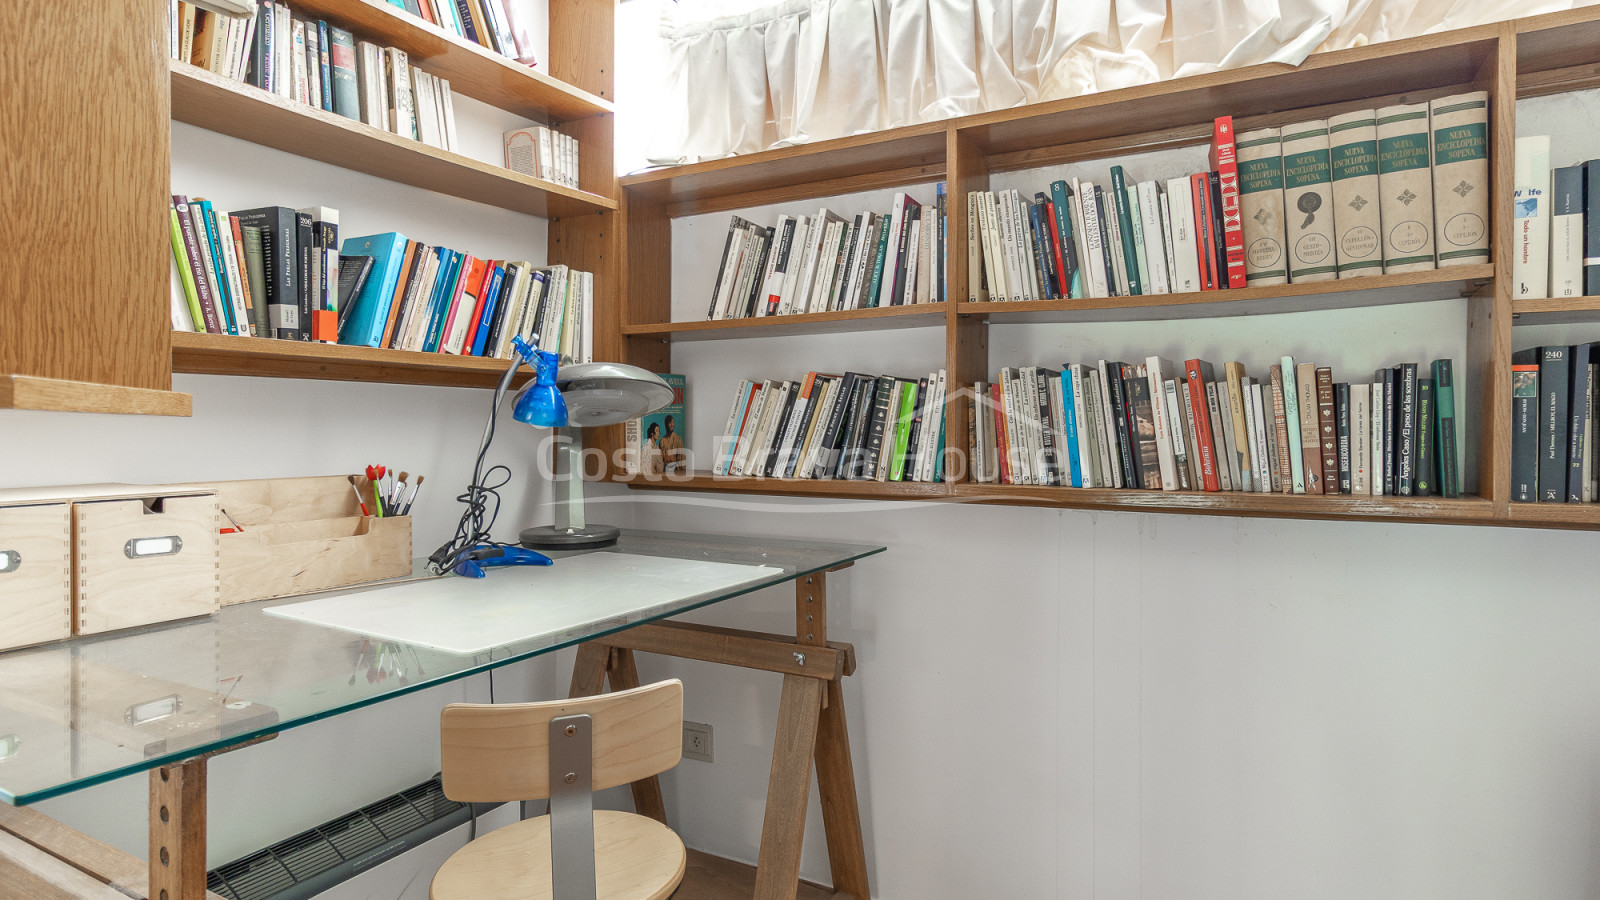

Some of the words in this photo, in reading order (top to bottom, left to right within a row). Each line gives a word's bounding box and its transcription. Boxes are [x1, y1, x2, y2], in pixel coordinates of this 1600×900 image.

[1449, 129, 1472, 140] NUEVA
[1392, 139, 1413, 150] NUEVA
[1344, 147, 1365, 157] NUEVA
[1296, 155, 1316, 165] NUEVA
[1250, 161, 1269, 171] NUEVA
[300, 215, 313, 226] 206
[183, 225, 194, 246] puente
[189, 245, 199, 261] sobre
[1545, 351, 1562, 360] 240
[1403, 413, 1411, 427] peso
